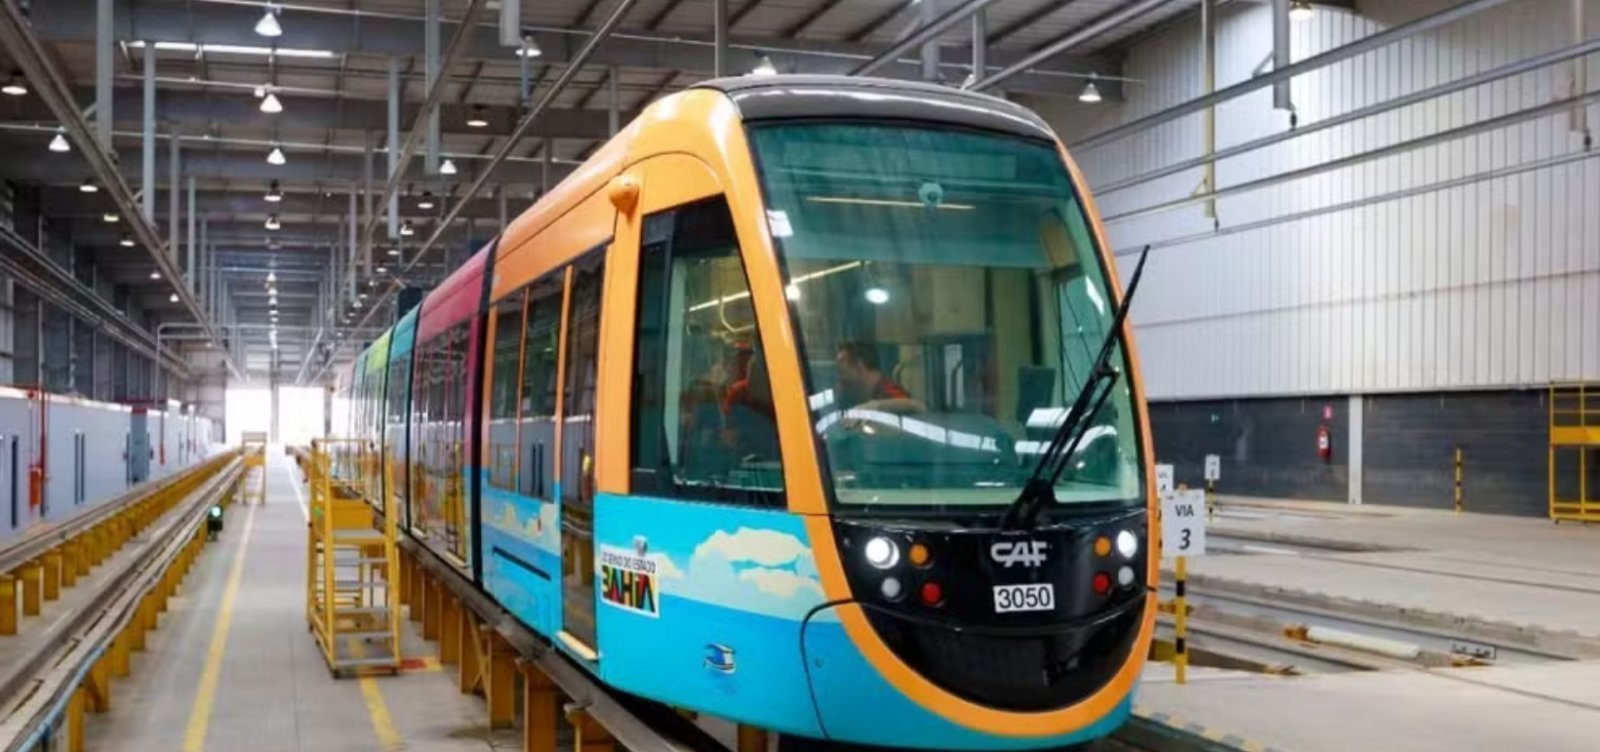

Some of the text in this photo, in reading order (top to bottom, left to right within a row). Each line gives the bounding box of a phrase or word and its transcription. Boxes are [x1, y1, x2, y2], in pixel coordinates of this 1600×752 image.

[1174, 504, 1195, 517] VIA
[1178, 528, 1192, 550] 3
[990, 541, 1047, 568] CAF
[602, 564, 656, 613] BAHIA
[998, 586, 1051, 609] 3050
